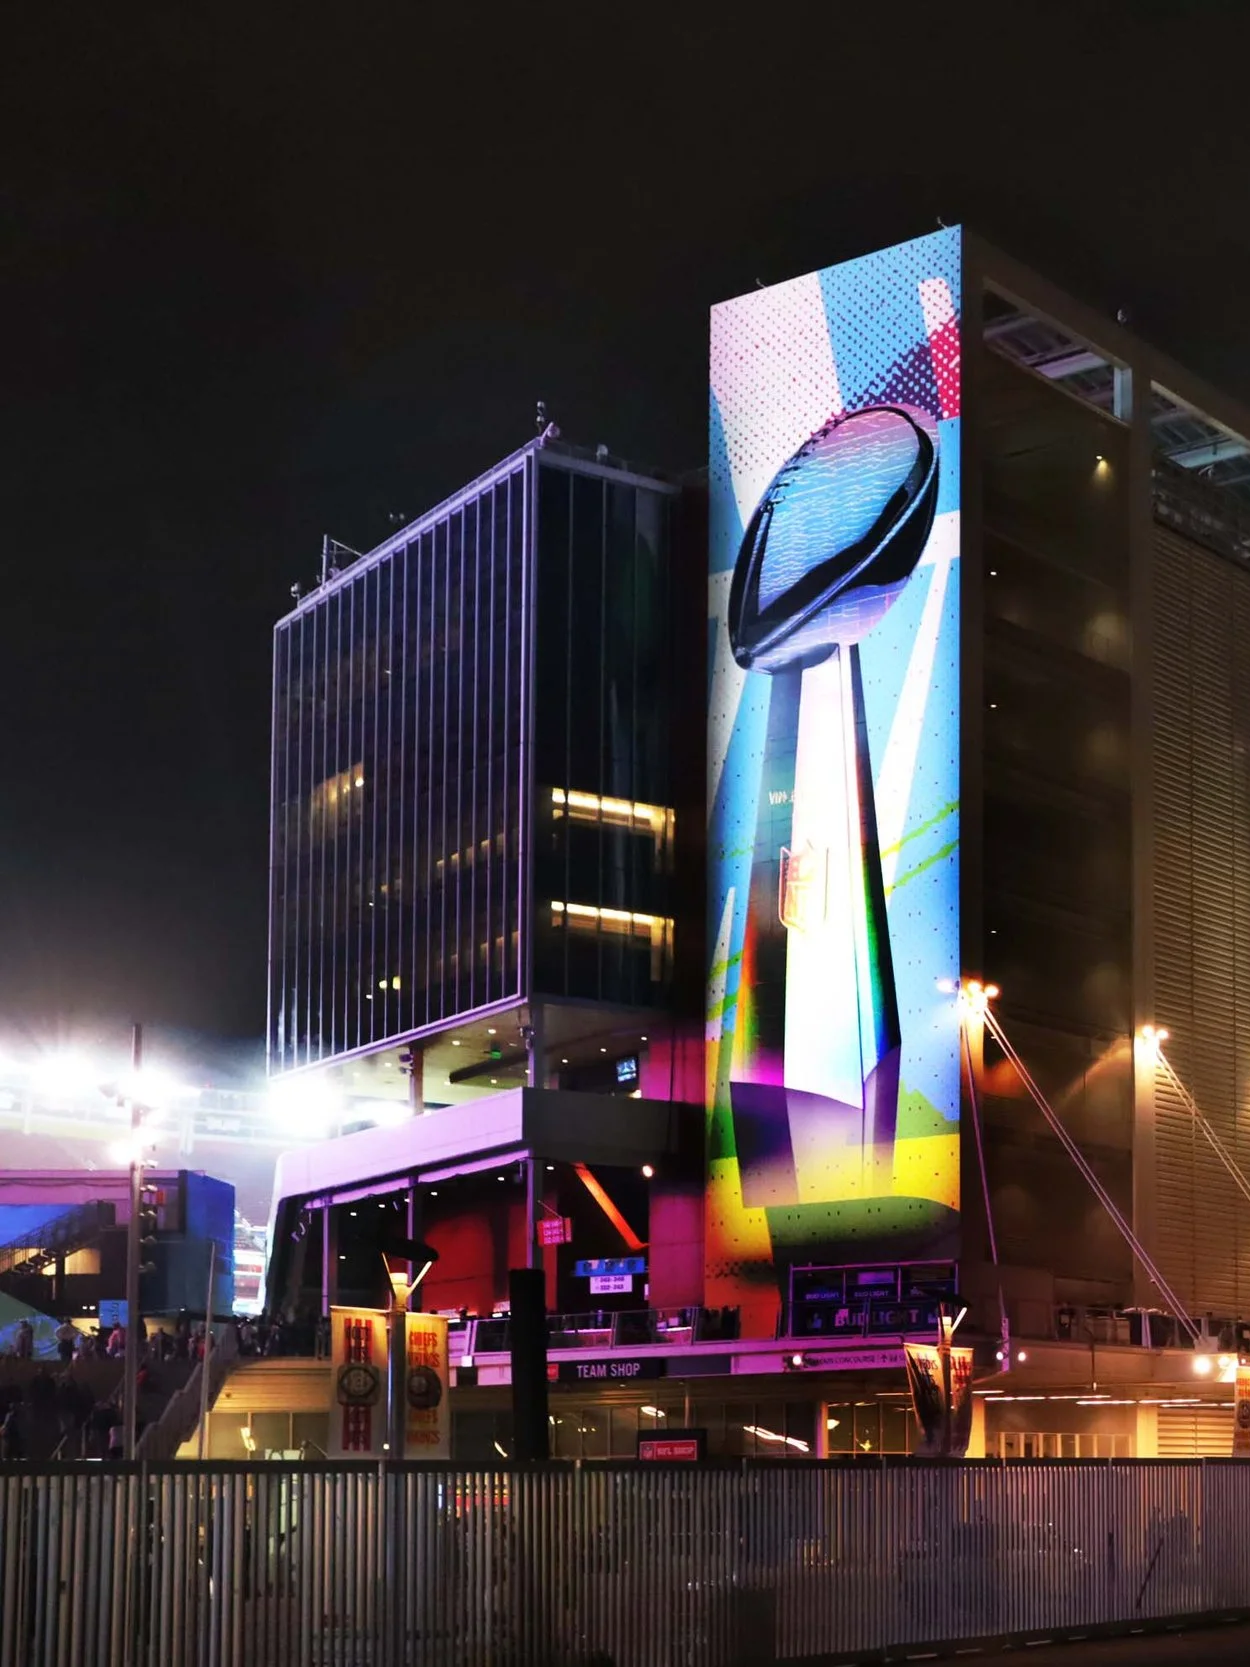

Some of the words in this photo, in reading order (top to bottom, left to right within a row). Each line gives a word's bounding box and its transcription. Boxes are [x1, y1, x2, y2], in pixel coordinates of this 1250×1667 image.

[834, 1308, 867, 1327] BUD
[872, 1308, 920, 1326] LIGHT
[577, 1363, 608, 1379] TEAM
[610, 1362, 641, 1377] SHOP
